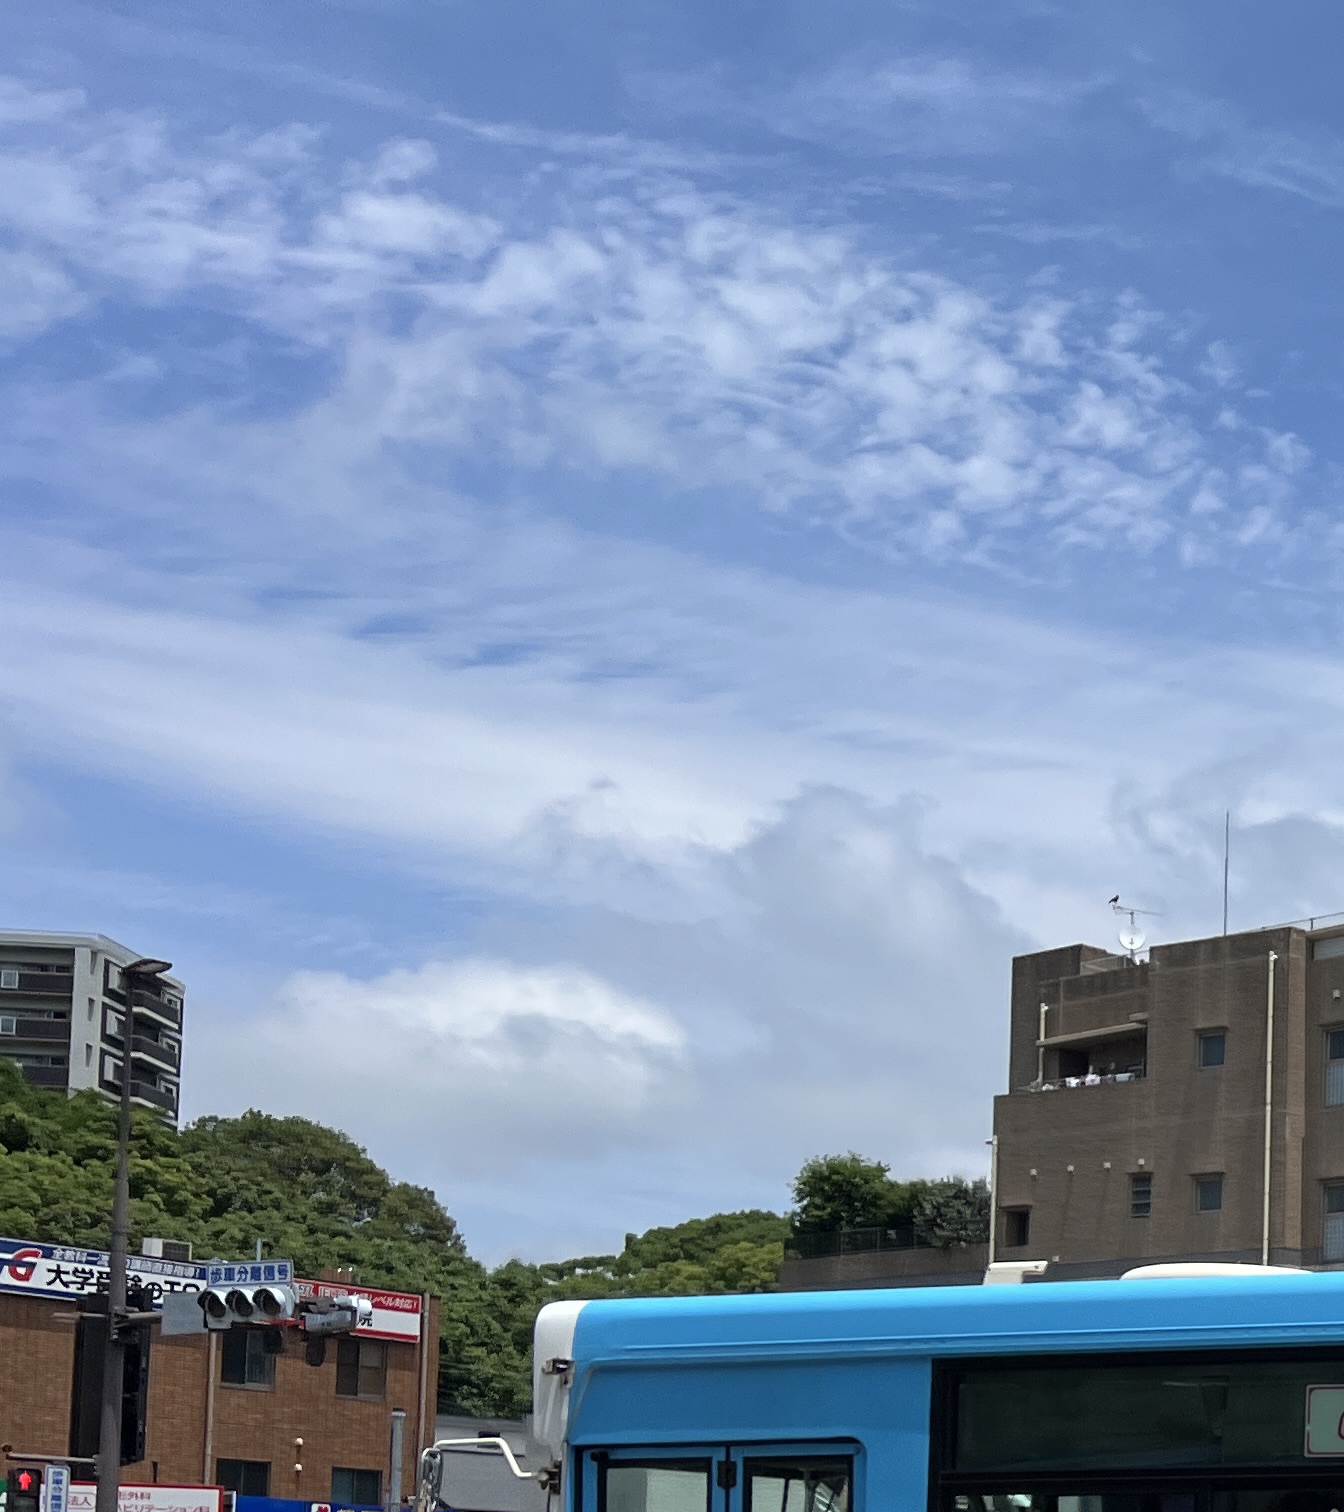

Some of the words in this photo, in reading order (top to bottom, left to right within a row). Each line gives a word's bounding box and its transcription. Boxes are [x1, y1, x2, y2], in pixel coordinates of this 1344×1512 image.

[210, 1263, 289, 1284] 歩車分離信号
